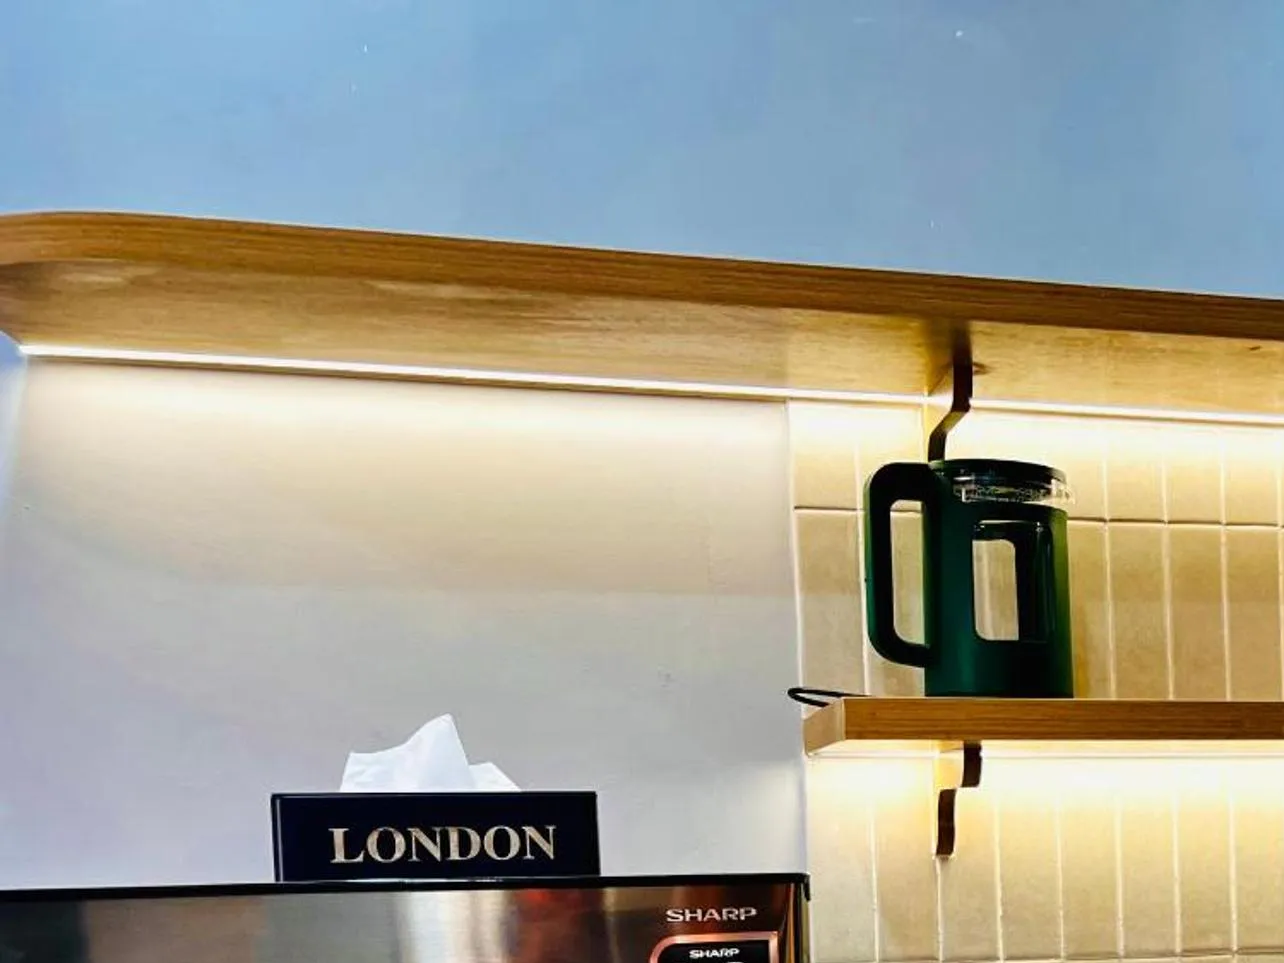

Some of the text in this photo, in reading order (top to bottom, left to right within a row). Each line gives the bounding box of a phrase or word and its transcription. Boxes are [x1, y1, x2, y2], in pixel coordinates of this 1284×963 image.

[329, 824, 557, 864] LONDON
[665, 907, 758, 923] SHARP
[689, 947, 740, 959] SHARP
